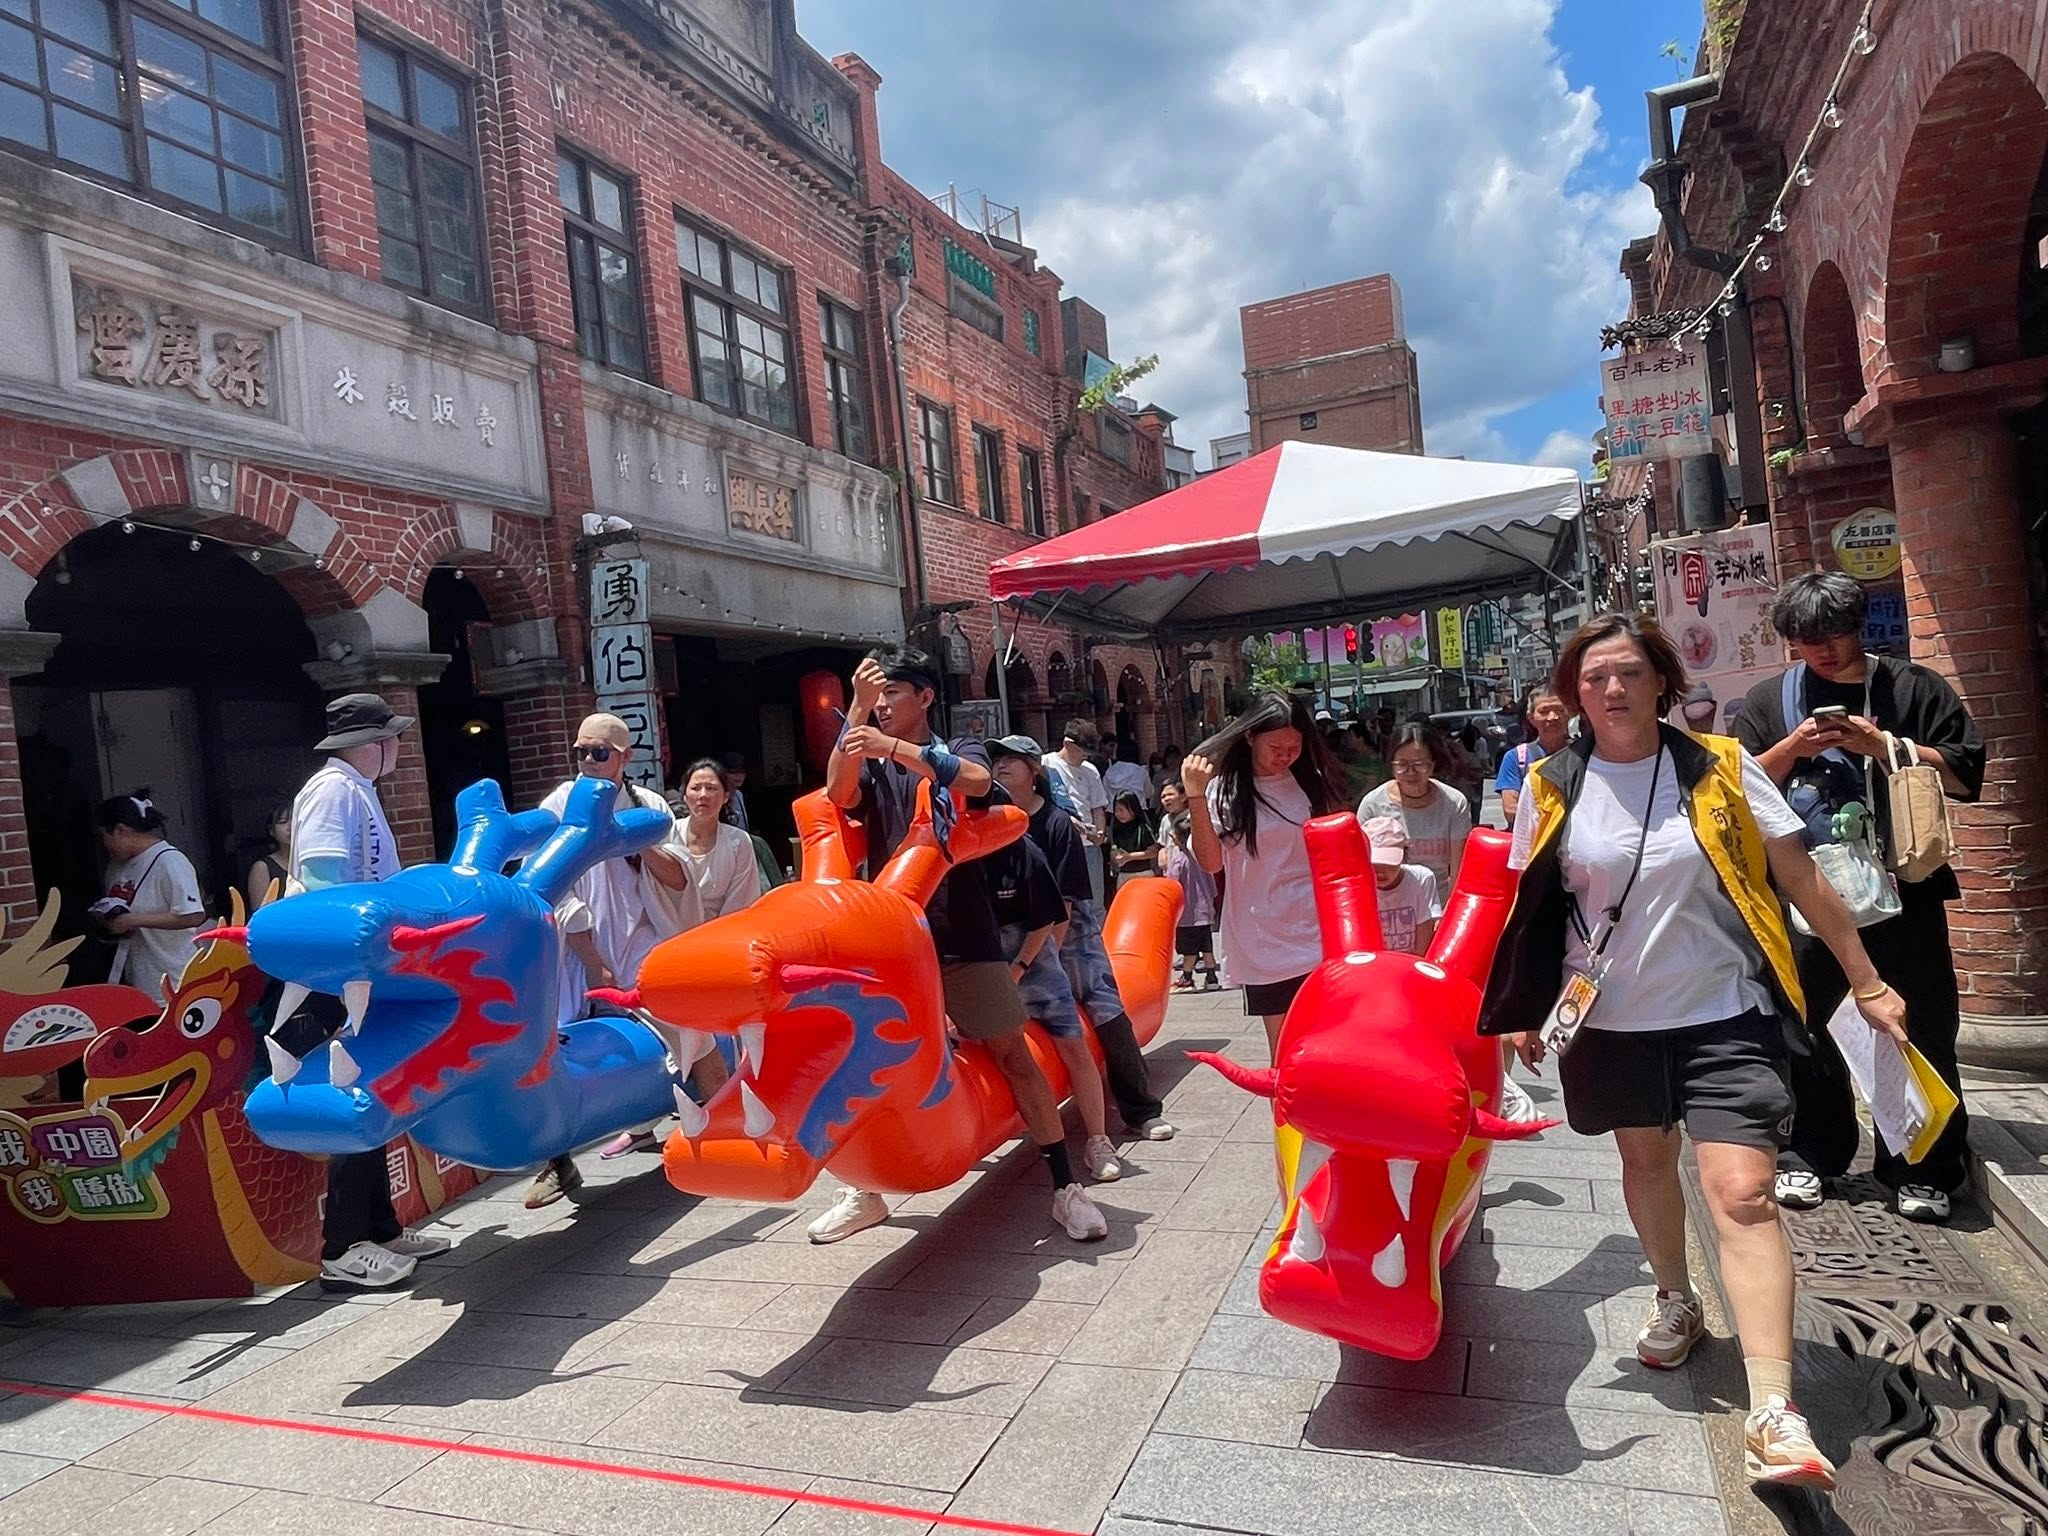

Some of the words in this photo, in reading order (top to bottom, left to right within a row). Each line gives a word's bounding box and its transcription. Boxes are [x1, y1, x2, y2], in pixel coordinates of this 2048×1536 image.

[1608, 352, 1697, 381] 百年老街
[1611, 412, 1705, 446] 手工豆花
[601, 563, 656, 786] 勇伯豆
[46, 1127, 119, 1160] 中園
[20, 1177, 59, 1210] 我
